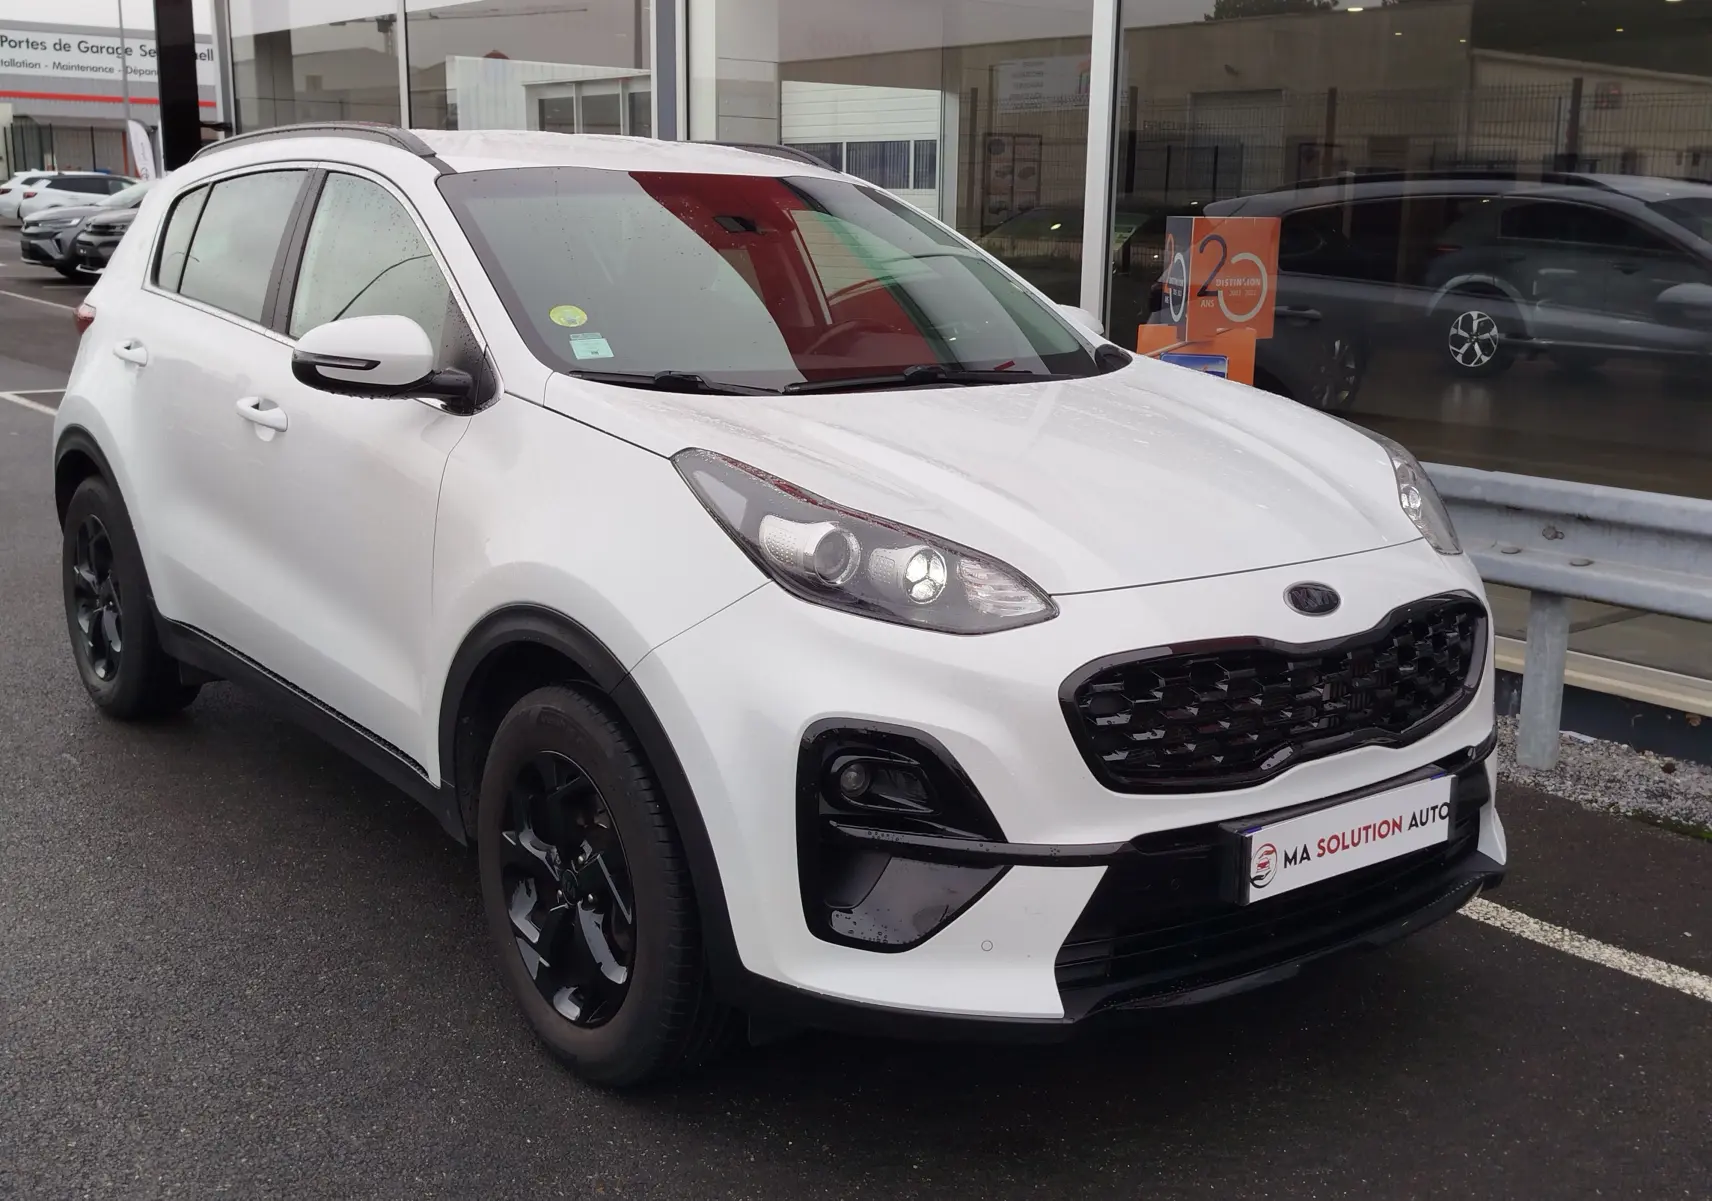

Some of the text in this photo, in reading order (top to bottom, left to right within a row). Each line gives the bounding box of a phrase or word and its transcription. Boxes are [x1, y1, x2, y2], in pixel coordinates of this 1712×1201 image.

[0, 35, 47, 50] Portes
[53, 38, 71, 52] de
[77, 40, 133, 59] Garage
[52, 61, 115, 74] Maintenance
[126, 65, 158, 77] Dépan
[1200, 299, 1215, 308] ANS
[1283, 802, 1451, 869] MA SOLUTION AUTO
